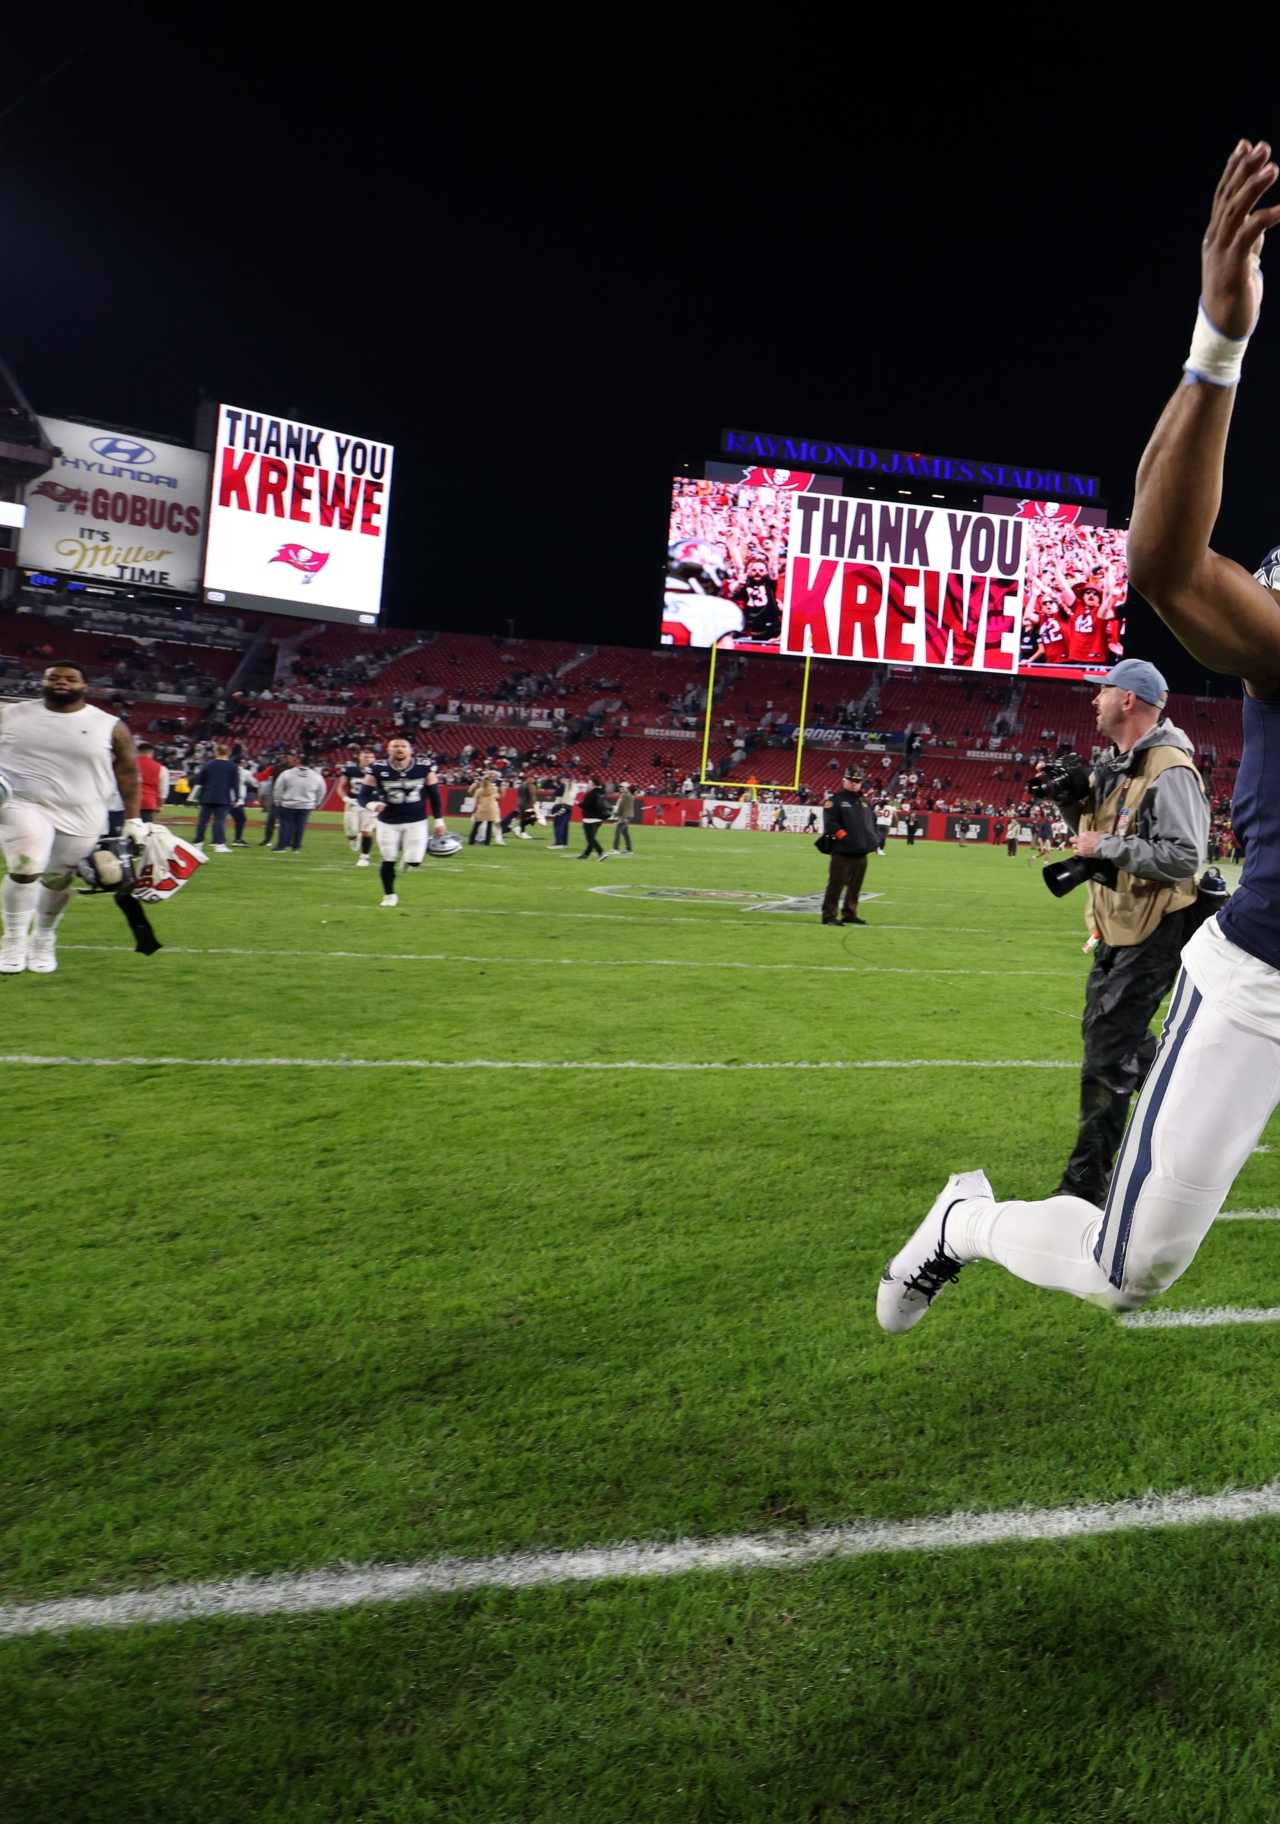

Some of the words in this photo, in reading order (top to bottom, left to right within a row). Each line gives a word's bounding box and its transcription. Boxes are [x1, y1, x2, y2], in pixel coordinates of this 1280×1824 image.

[226, 409, 325, 467] THANK
[334, 436, 387, 480] YOU
[727, 431, 877, 470] RAYMOND
[881, 452, 974, 483] JAMES
[979, 466, 1095, 498] STADIUM
[60, 456, 178, 489] HYUNDAI
[219, 446, 384, 537] KREWE
[74, 487, 200, 537] #GOBUCS
[80, 526, 110, 543] IT'S
[796, 494, 933, 568] THANK
[946, 512, 1023, 577] YOU
[55, 538, 173, 571] Miller
[117, 563, 171, 587] TIME
[787, 555, 1020, 671] KREWE
[381, 778, 425, 804] 57
